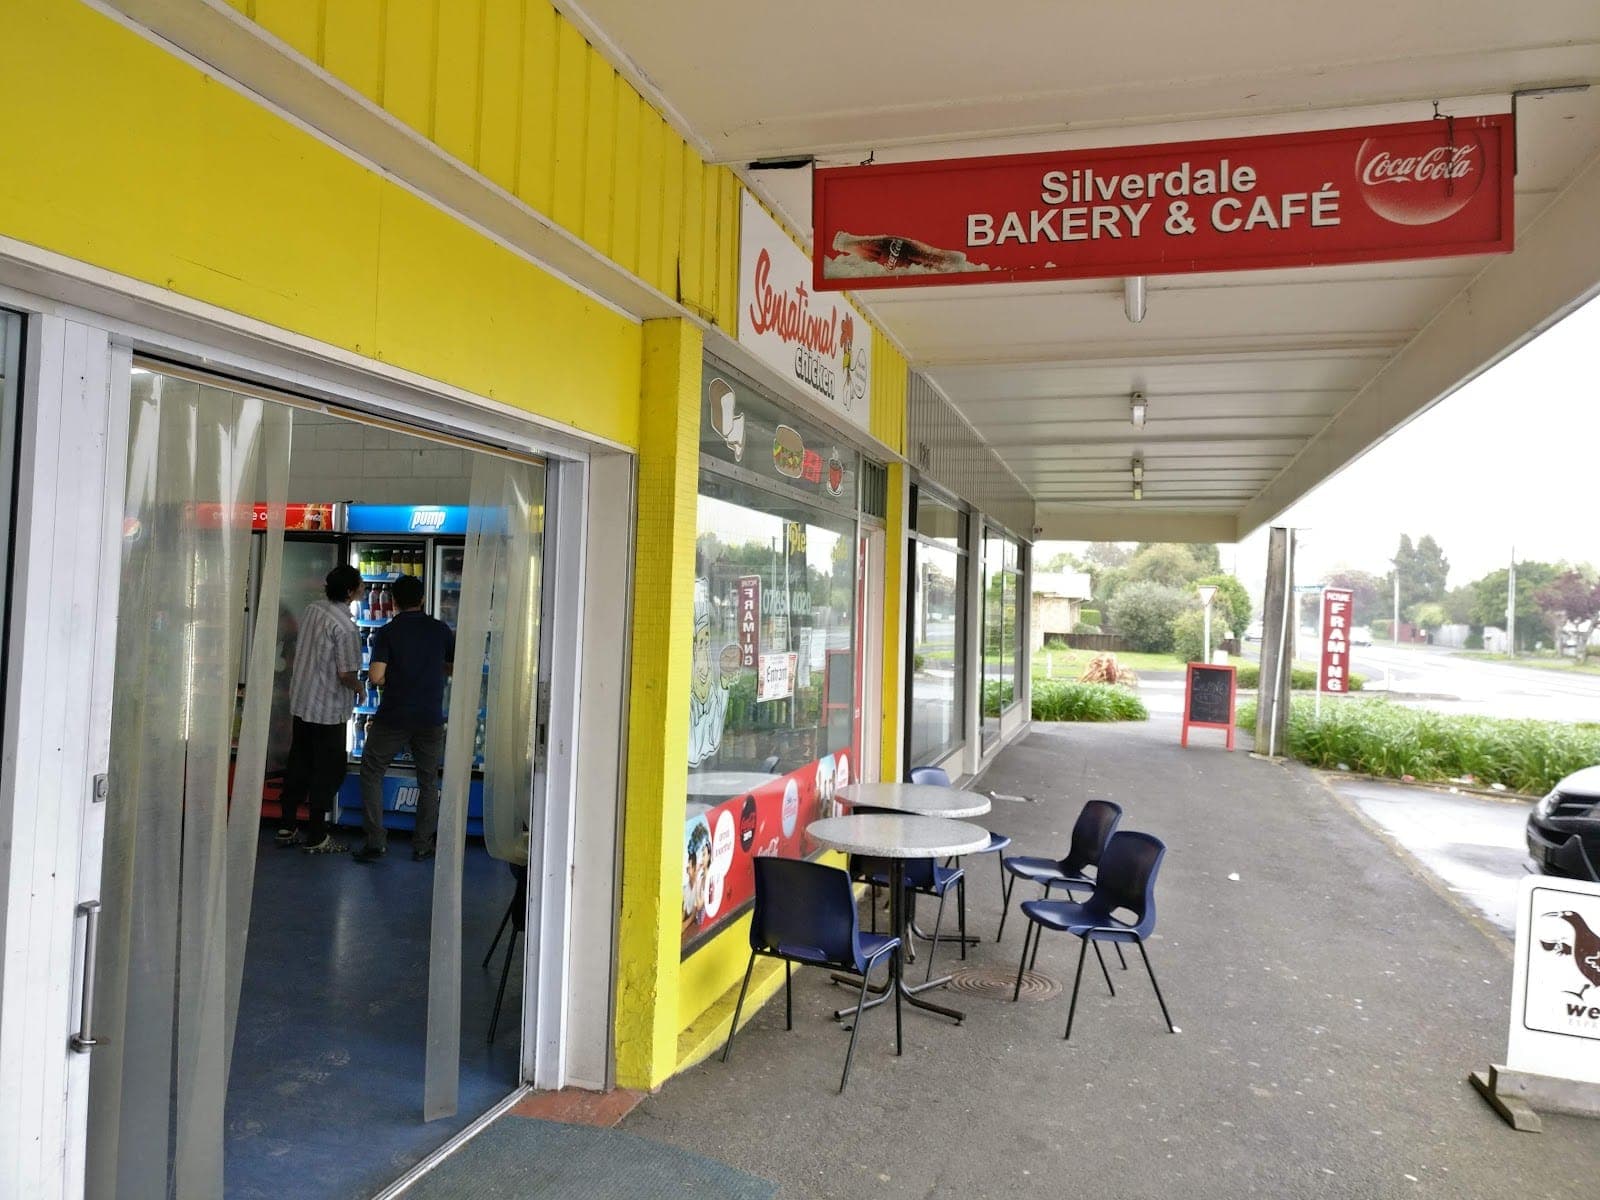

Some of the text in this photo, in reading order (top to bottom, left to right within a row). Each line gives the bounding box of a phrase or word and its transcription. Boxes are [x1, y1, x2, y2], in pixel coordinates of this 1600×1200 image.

[1041, 158, 1257, 205] Silverdale
[1362, 144, 1477, 186] Coca-Cola
[966, 182, 1341, 248] BAKERY & CAFÉ
[749, 247, 837, 360] Sensational
[411, 510, 446, 530] pump
[1327, 603, 1346, 691] FRAMING
